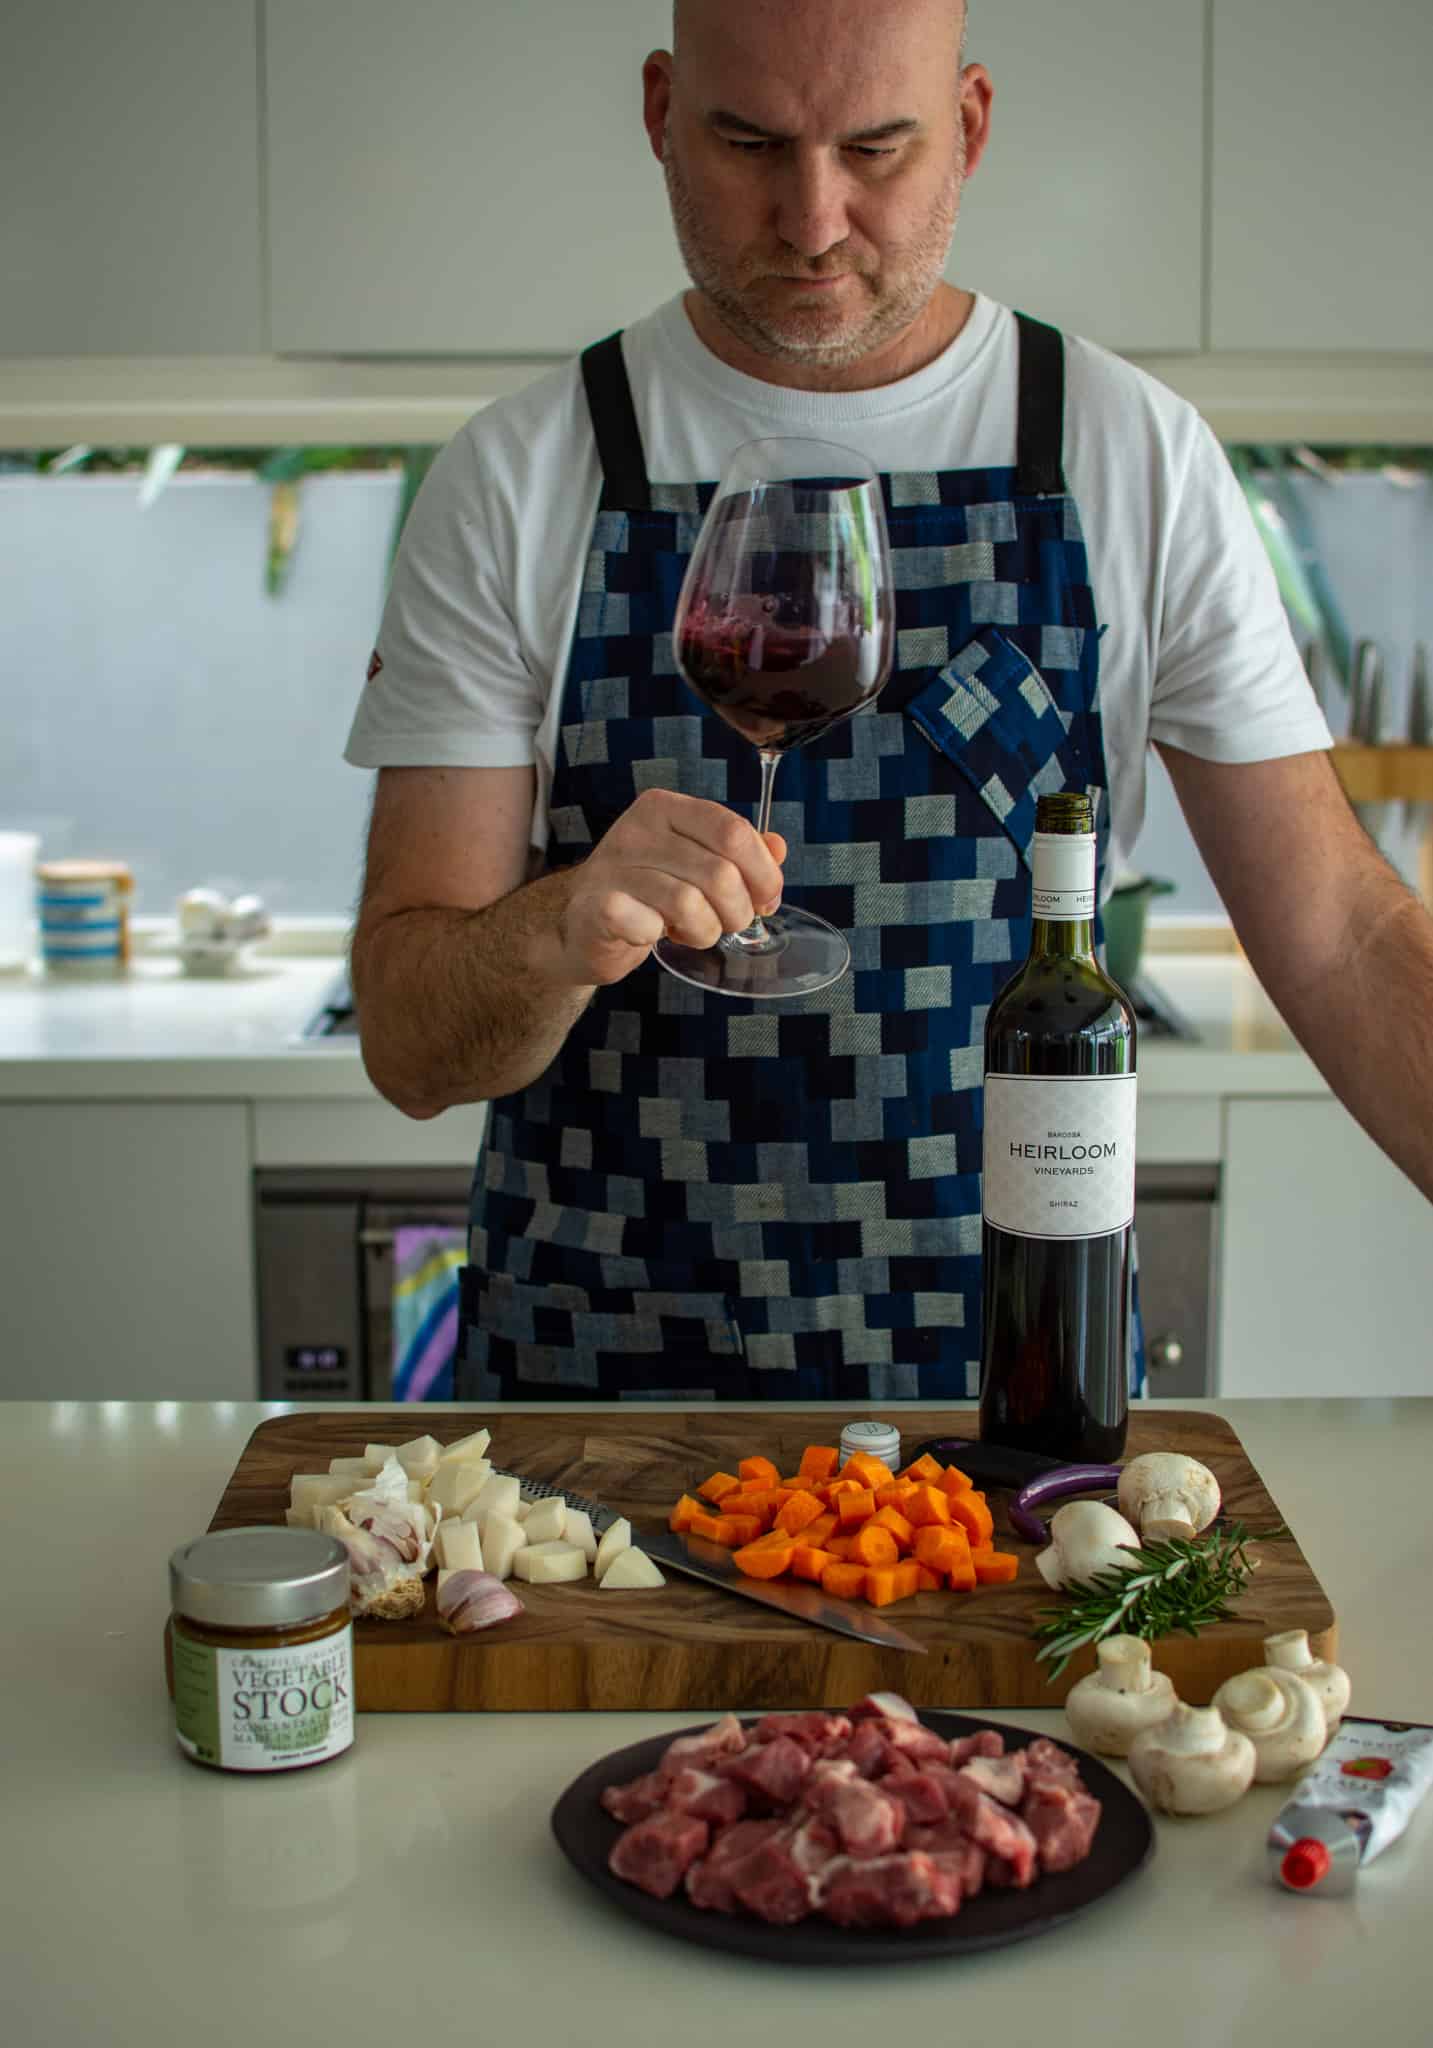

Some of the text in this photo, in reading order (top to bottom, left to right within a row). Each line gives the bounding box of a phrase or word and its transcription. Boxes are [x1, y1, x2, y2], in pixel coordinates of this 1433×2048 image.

[1009, 1142, 1116, 1160] HEIRLOOM
[1034, 1166, 1095, 1176] VINEYARDS
[1048, 1200, 1079, 1208] SHIRAZ
[232, 1650, 346, 1688] VEGETABLE
[233, 1671, 348, 1720] STOCK
